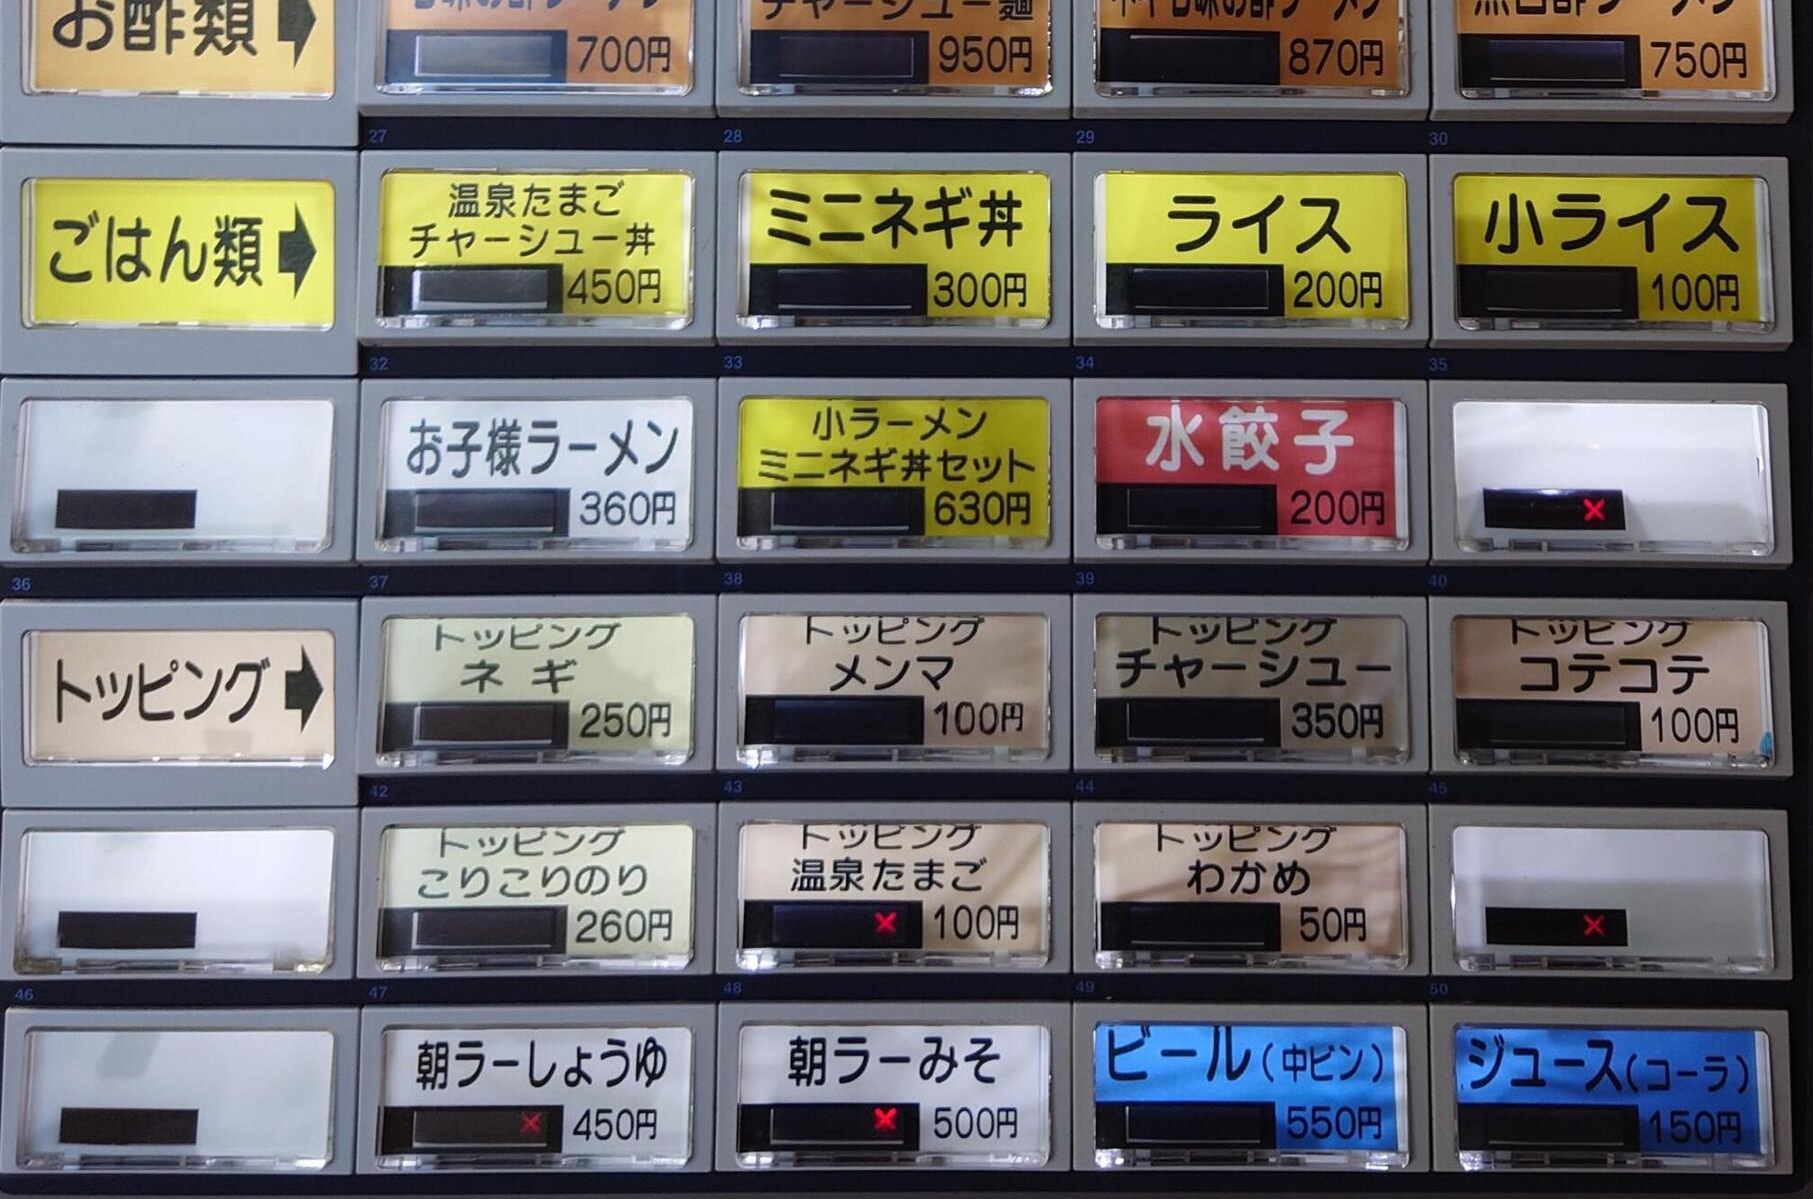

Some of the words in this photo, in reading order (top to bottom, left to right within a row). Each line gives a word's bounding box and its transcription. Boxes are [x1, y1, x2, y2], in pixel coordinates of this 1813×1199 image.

[577, 35, 672, 74] 700円
[939, 36, 1032, 73] 950円
[1289, 39, 1384, 76] 870円
[1651, 41, 1747, 79] 750円
[369, 128, 388, 144] 27
[724, 130, 742, 143] 28
[1076, 130, 1095, 144] 29
[1429, 131, 1448, 146] 30
[448, 182, 625, 218] 温泉たまご
[768, 186, 1022, 249] ミニネギ丼
[1168, 195, 1351, 254] ライス
[1485, 192, 1739, 253] 小ライス
[48, 215, 263, 288] ごはん類
[410, 223, 656, 254] チャーシュー丼
[567, 269, 662, 305] 450円
[933, 272, 1026, 308] 300円
[1294, 272, 1383, 309] 200円
[1652, 273, 1740, 312] 100円
[369, 356, 388, 371] 32
[724, 356, 742, 369] 33
[1076, 356, 1094, 370] 34
[1428, 357, 1447, 371] 35
[812, 406, 987, 440] 小ラーメン
[1145, 405, 1354, 475] 水餃子
[408, 418, 679, 479] お子様ラーメン
[759, 448, 1035, 483] ミニネギ丼セット
[580, 491, 677, 528] 360円
[934, 491, 1030, 526] 630円
[1290, 491, 1385, 526] 200円
[12, 577, 31, 593] 36
[370, 574, 388, 589] 37
[724, 572, 743, 585] 38
[1076, 572, 1094, 585] 39
[1428, 573, 1447, 587] 40
[806, 616, 985, 645] トッピング
[830, 655, 953, 691] メンマ
[1116, 648, 1391, 689] チャーシュー
[1520, 653, 1710, 695] コテコテ
[56, 659, 270, 725] トッピング
[581, 702, 672, 739] 250円
[933, 701, 1023, 735] 100円
[1291, 703, 1384, 739] 350円
[1652, 707, 1739, 744] 100円
[370, 784, 388, 799] 42
[724, 780, 742, 793] 43
[1076, 780, 1094, 793] 44
[1428, 780, 1447, 795] 45
[1155, 825, 1337, 854] トッピング
[418, 865, 648, 899] こりこりのり
[791, 857, 988, 892] 温泉たまご
[1187, 859, 1311, 895] わかめ
[576, 910, 673, 944] 260円
[934, 905, 1019, 941] 100円
[1299, 906, 1366, 942] 50円
[15, 987, 34, 1002] 46
[369, 985, 388, 999] 47
[723, 981, 742, 994] 48
[1076, 980, 1094, 994] 49
[1429, 982, 1448, 996] 50
[416, 1038, 668, 1091] 朝ラーしょうゆ
[788, 1036, 1000, 1086] 朝ラーみそ
[573, 1108, 658, 1142] 450円
[934, 1107, 1018, 1139] 500円
[1286, 1108, 1382, 1139] 550円
[1647, 1112, 1742, 1143] 150円
